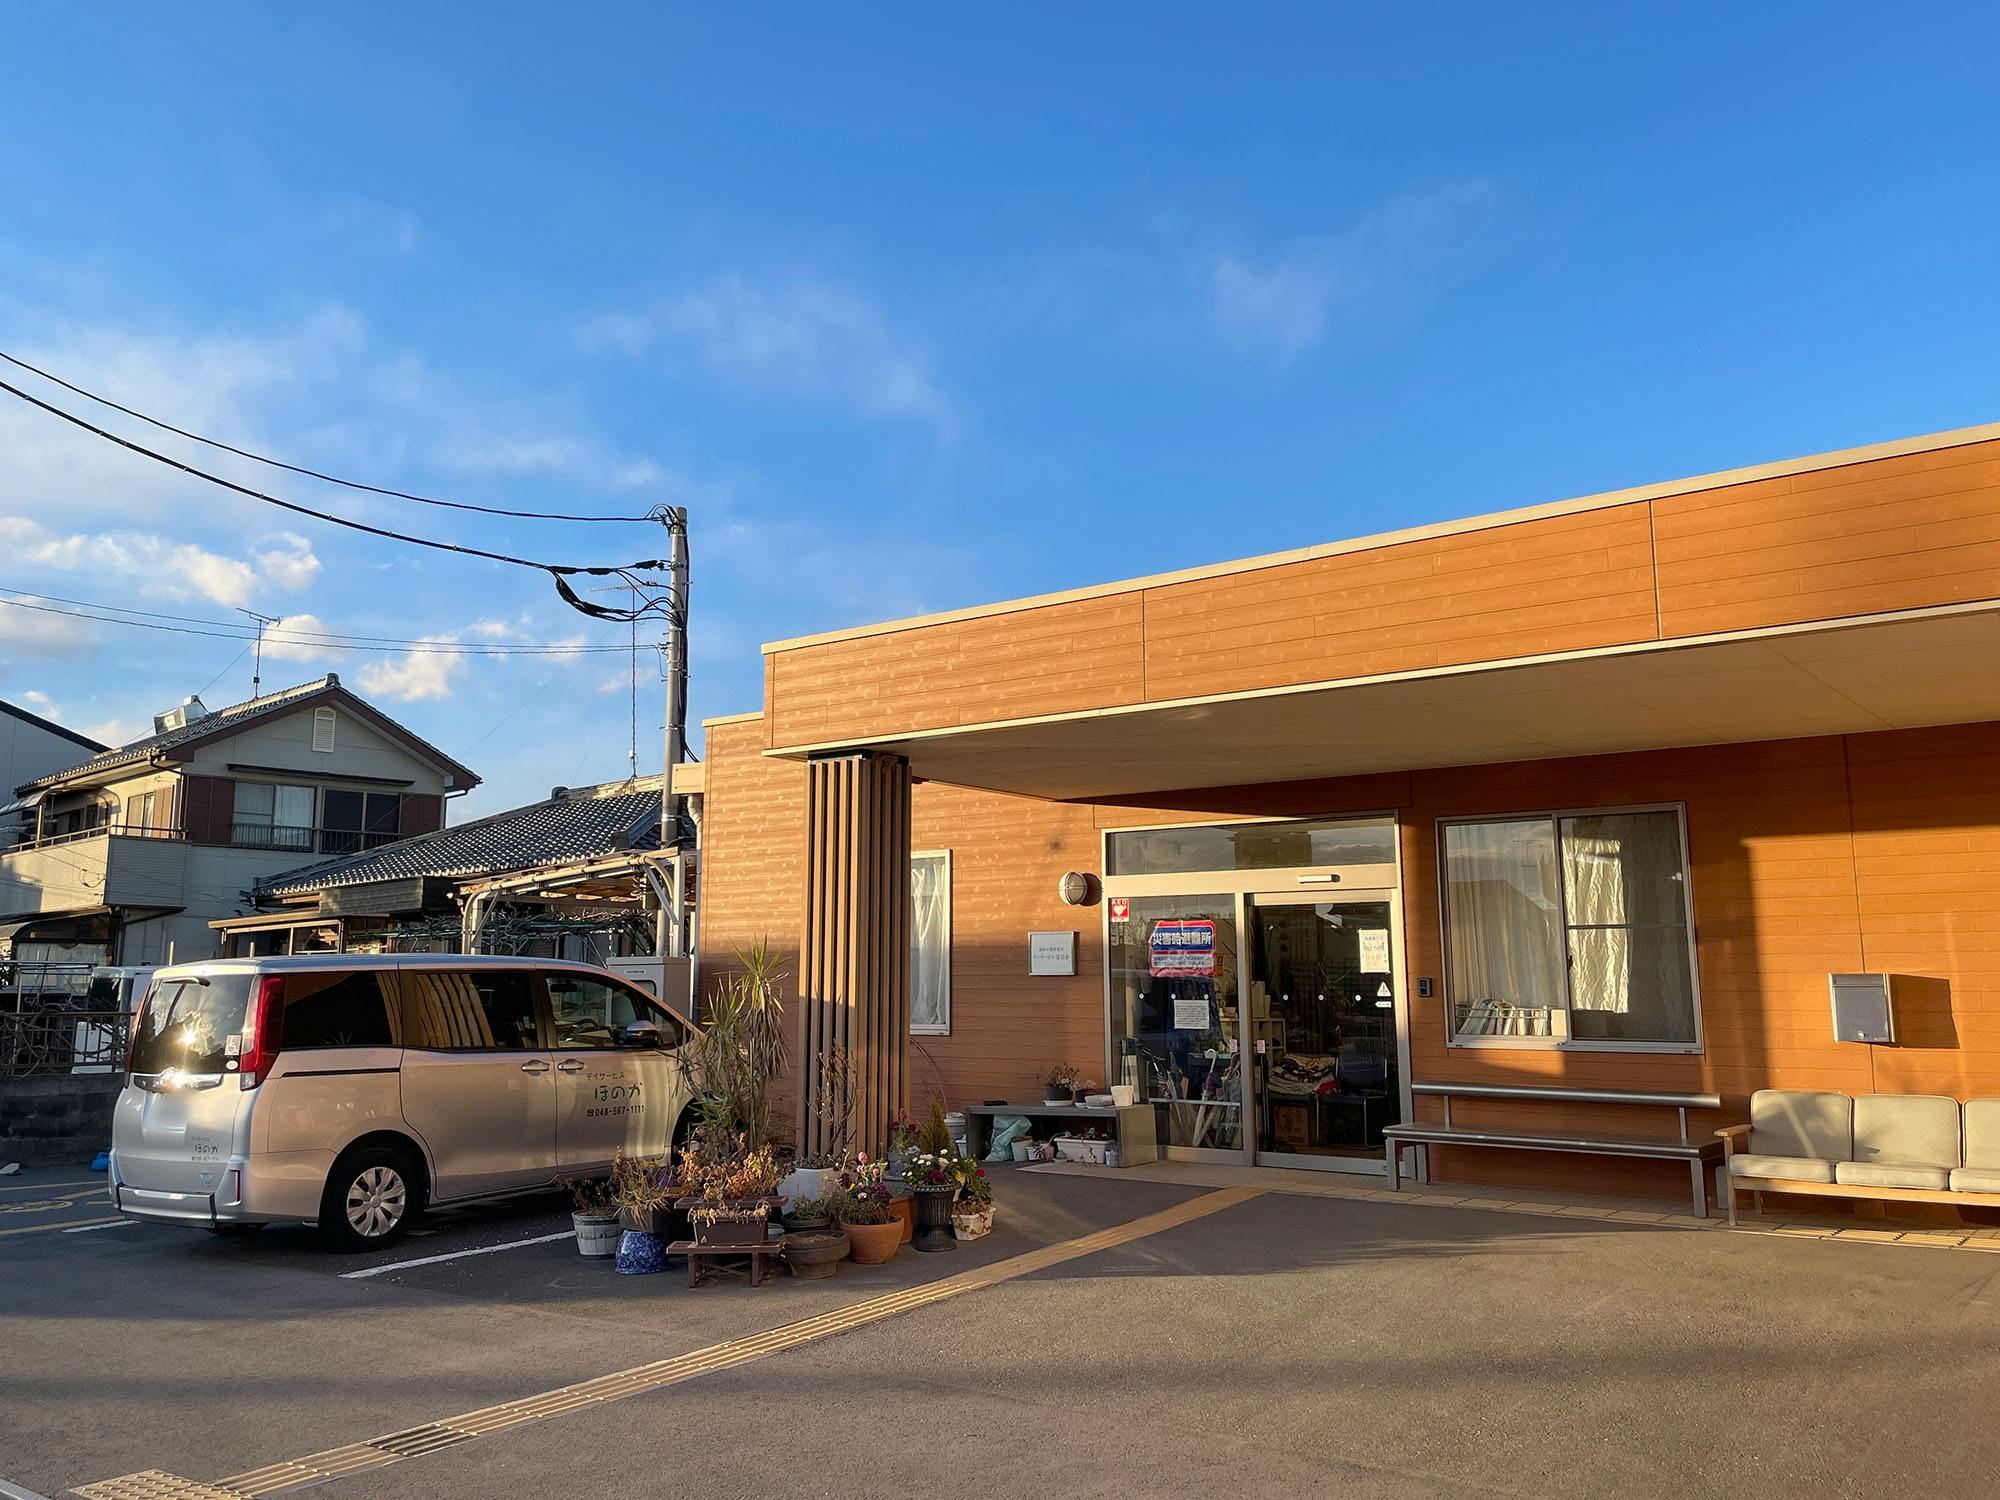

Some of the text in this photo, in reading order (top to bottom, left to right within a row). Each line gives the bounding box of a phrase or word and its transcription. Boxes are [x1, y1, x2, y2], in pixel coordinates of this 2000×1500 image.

[1152, 931, 1211, 946] 災害時避難所
[586, 1072, 625, 1081] デイサービス
[595, 1082, 643, 1101] ほのか
